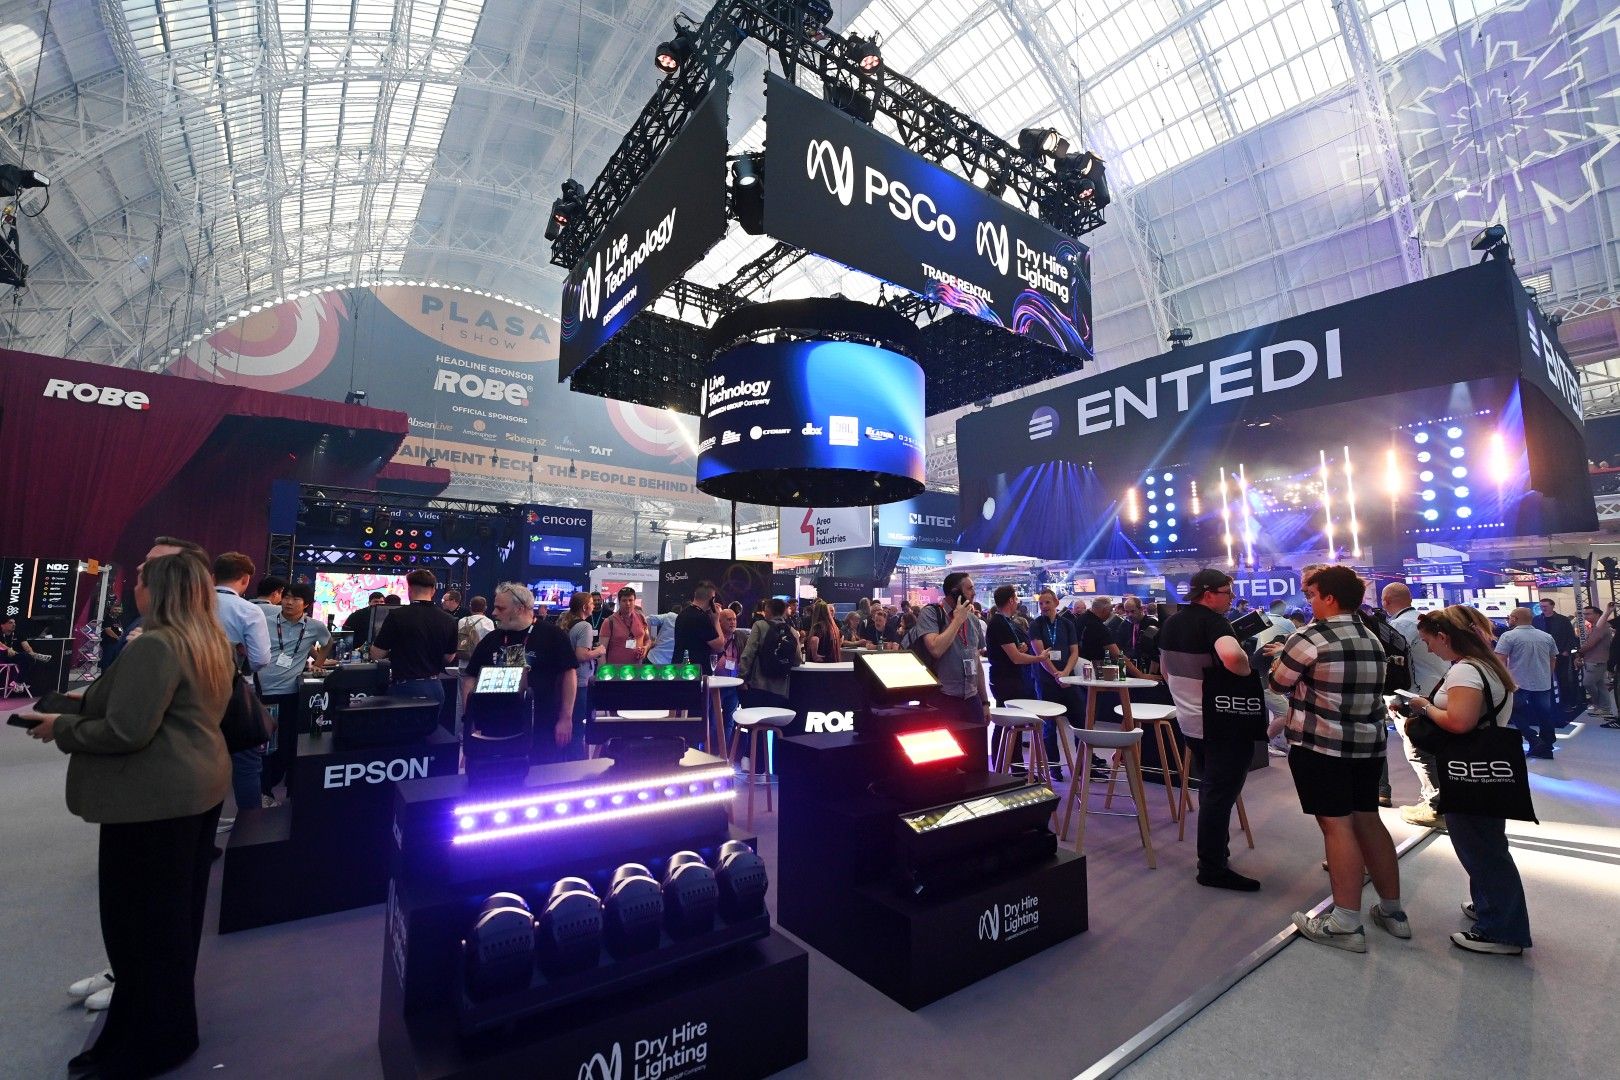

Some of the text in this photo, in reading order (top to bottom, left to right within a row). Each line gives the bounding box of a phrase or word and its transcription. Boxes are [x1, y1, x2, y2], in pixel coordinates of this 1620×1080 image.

[865, 166, 957, 241] PSCo
[604, 207, 676, 298] Technology
[605, 233, 628, 271] Live
[1016, 238, 1069, 279] Dry Hire
[922, 262, 994, 303] TRADE RENTAL
[1017, 259, 1069, 303] Lighting
[421, 294, 551, 344] PLASA
[459, 329, 517, 350] SHOW
[436, 354, 535, 382] HEADLINE SPONSOR
[1540, 329, 1585, 427] ENTED
[708, 380, 771, 407] Technology
[709, 374, 726, 392] Live
[1077, 328, 1342, 436] ENTEDI
[407, 416, 454, 432] AbsenLive
[452, 405, 528, 424] OFFICIAL SPONSORS
[588, 445, 613, 457] TAIT
[399, 444, 486, 466] AINMENT
[489, 455, 533, 472] TECH
[547, 464, 577, 478] THE
[580, 468, 636, 487] PEOPLE
[638, 476, 688, 492] BEHIND
[542, 513, 587, 527] encore
[816, 516, 831, 526] Area
[816, 526, 829, 536] Four
[917, 513, 953, 528] LITEC
[816, 534, 847, 546] Industries
[9, 563, 24, 604] WOLFMIX
[1233, 577, 1296, 597] TEDI
[1215, 695, 1261, 711] SES
[323, 756, 429, 789] EPSON
[1447, 760, 1513, 778] SES
[1004, 895, 1039, 917] Dry Hire
[1004, 910, 1039, 933] Lighting
[634, 1021, 708, 1061] Dry Hire
[634, 1042, 708, 1080] Lighting
